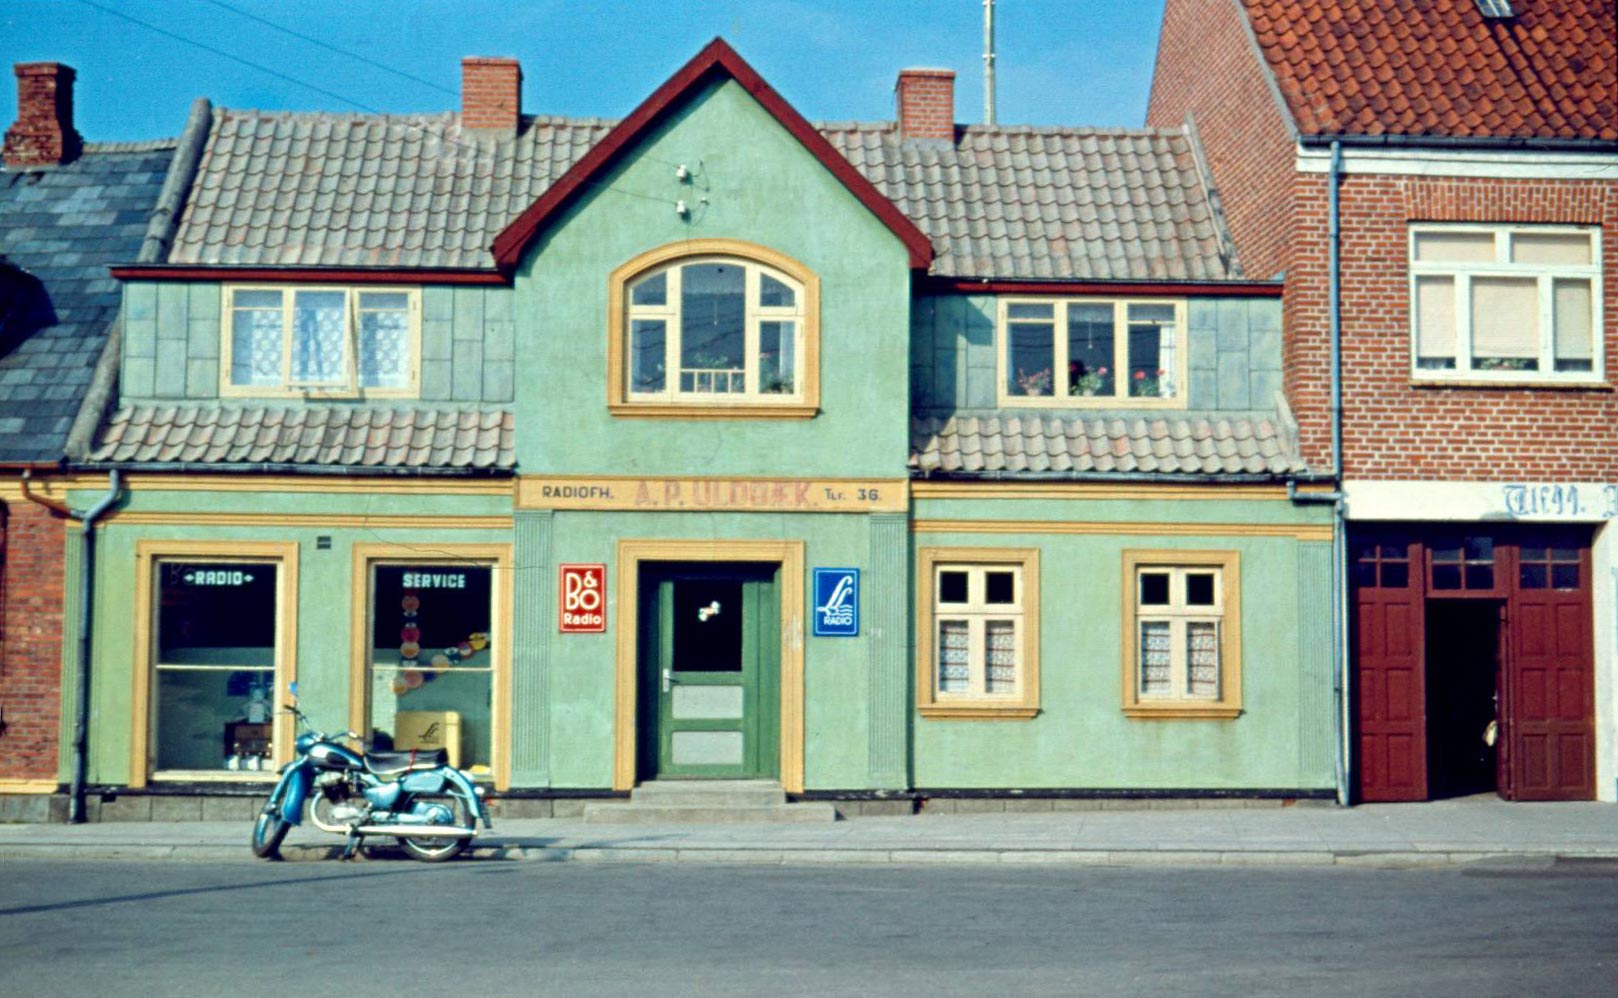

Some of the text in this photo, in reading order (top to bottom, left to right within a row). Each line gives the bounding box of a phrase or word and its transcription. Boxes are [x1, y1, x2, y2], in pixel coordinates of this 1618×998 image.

[195, 570, 243, 586] RADIO
[402, 573, 466, 589] SERVICE
[563, 612, 602, 625] Radio
[823, 615, 853, 626] RADIO
